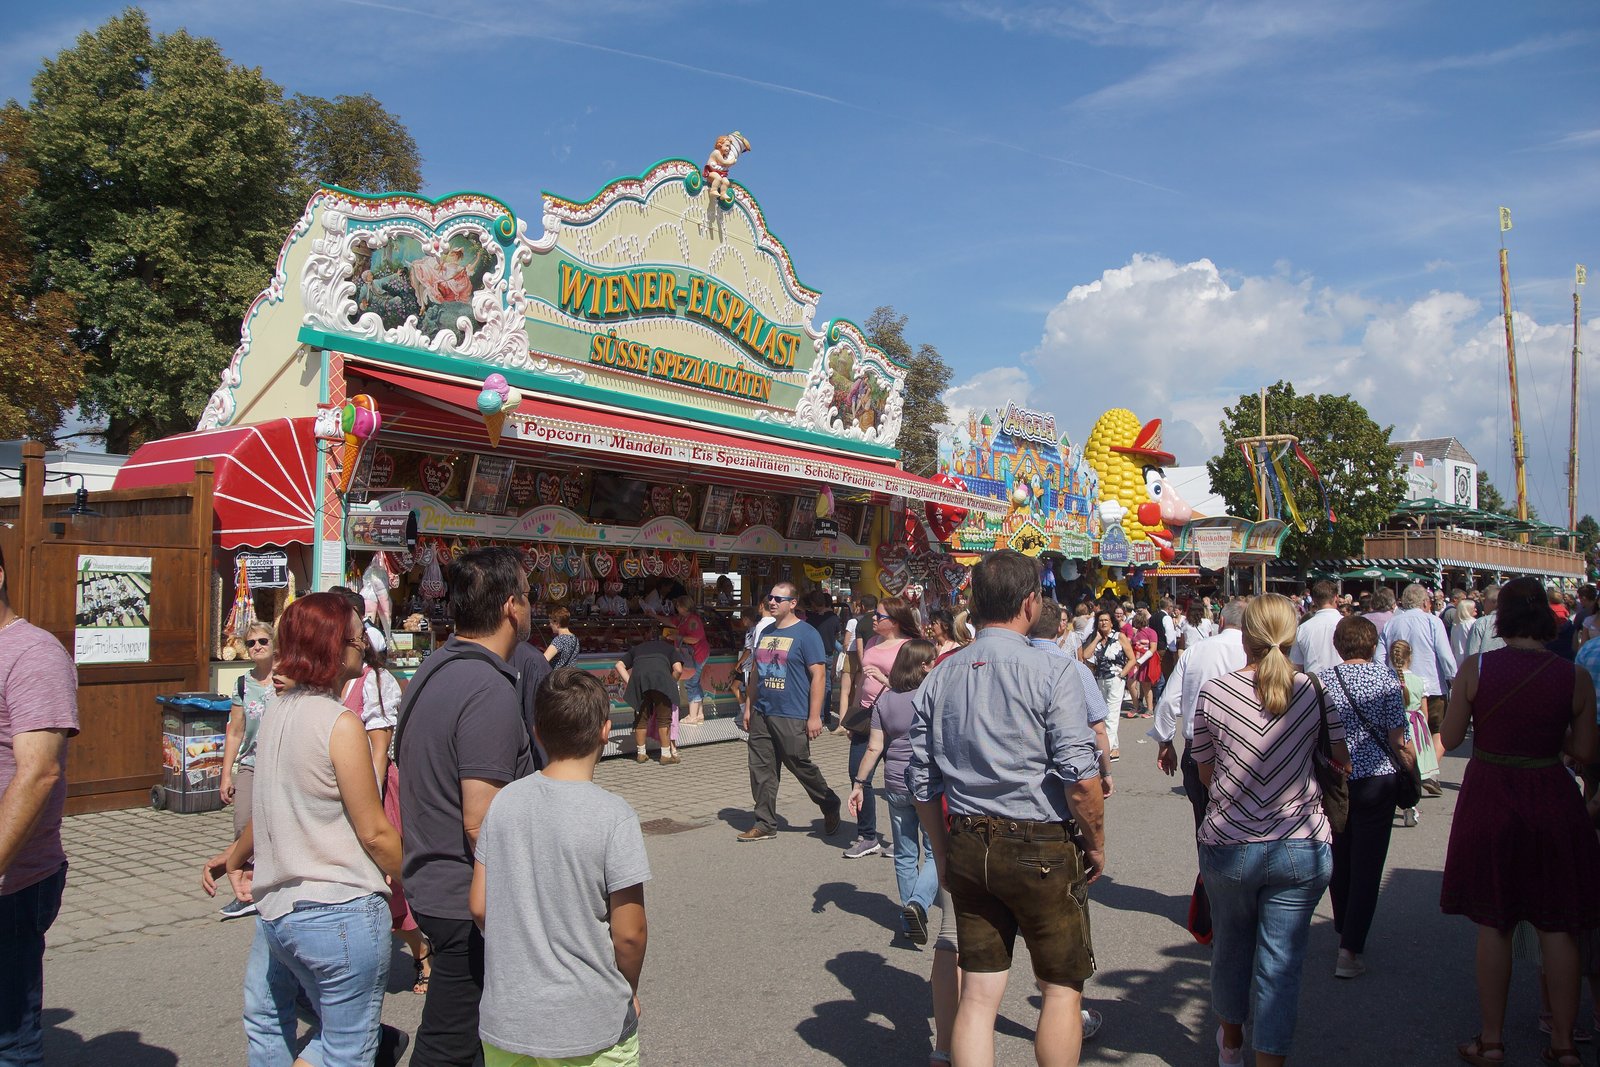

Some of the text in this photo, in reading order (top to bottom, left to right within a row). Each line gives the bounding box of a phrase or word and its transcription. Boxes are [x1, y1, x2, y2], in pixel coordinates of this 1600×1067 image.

[561, 264, 800, 367] WIENER-EISPALAST
[591, 329, 772, 401] SÜSSE SPEZIALITÄTEN
[523, 421, 591, 444] Popcorn
[609, 435, 673, 456] Mandeln
[692, 447, 713, 461] Eis
[716, 451, 790, 473] Spezialitäten
[804, 464, 840, 481] Schoko
[885, 481, 899, 493] Eis
[907, 485, 937, 501] Joghurt
[966, 495, 1004, 513] Variationen
[421, 506, 476, 532] Popcorn
[550, 518, 597, 539] Mandeln
[94, 634, 148, 655] Frühschoppen
